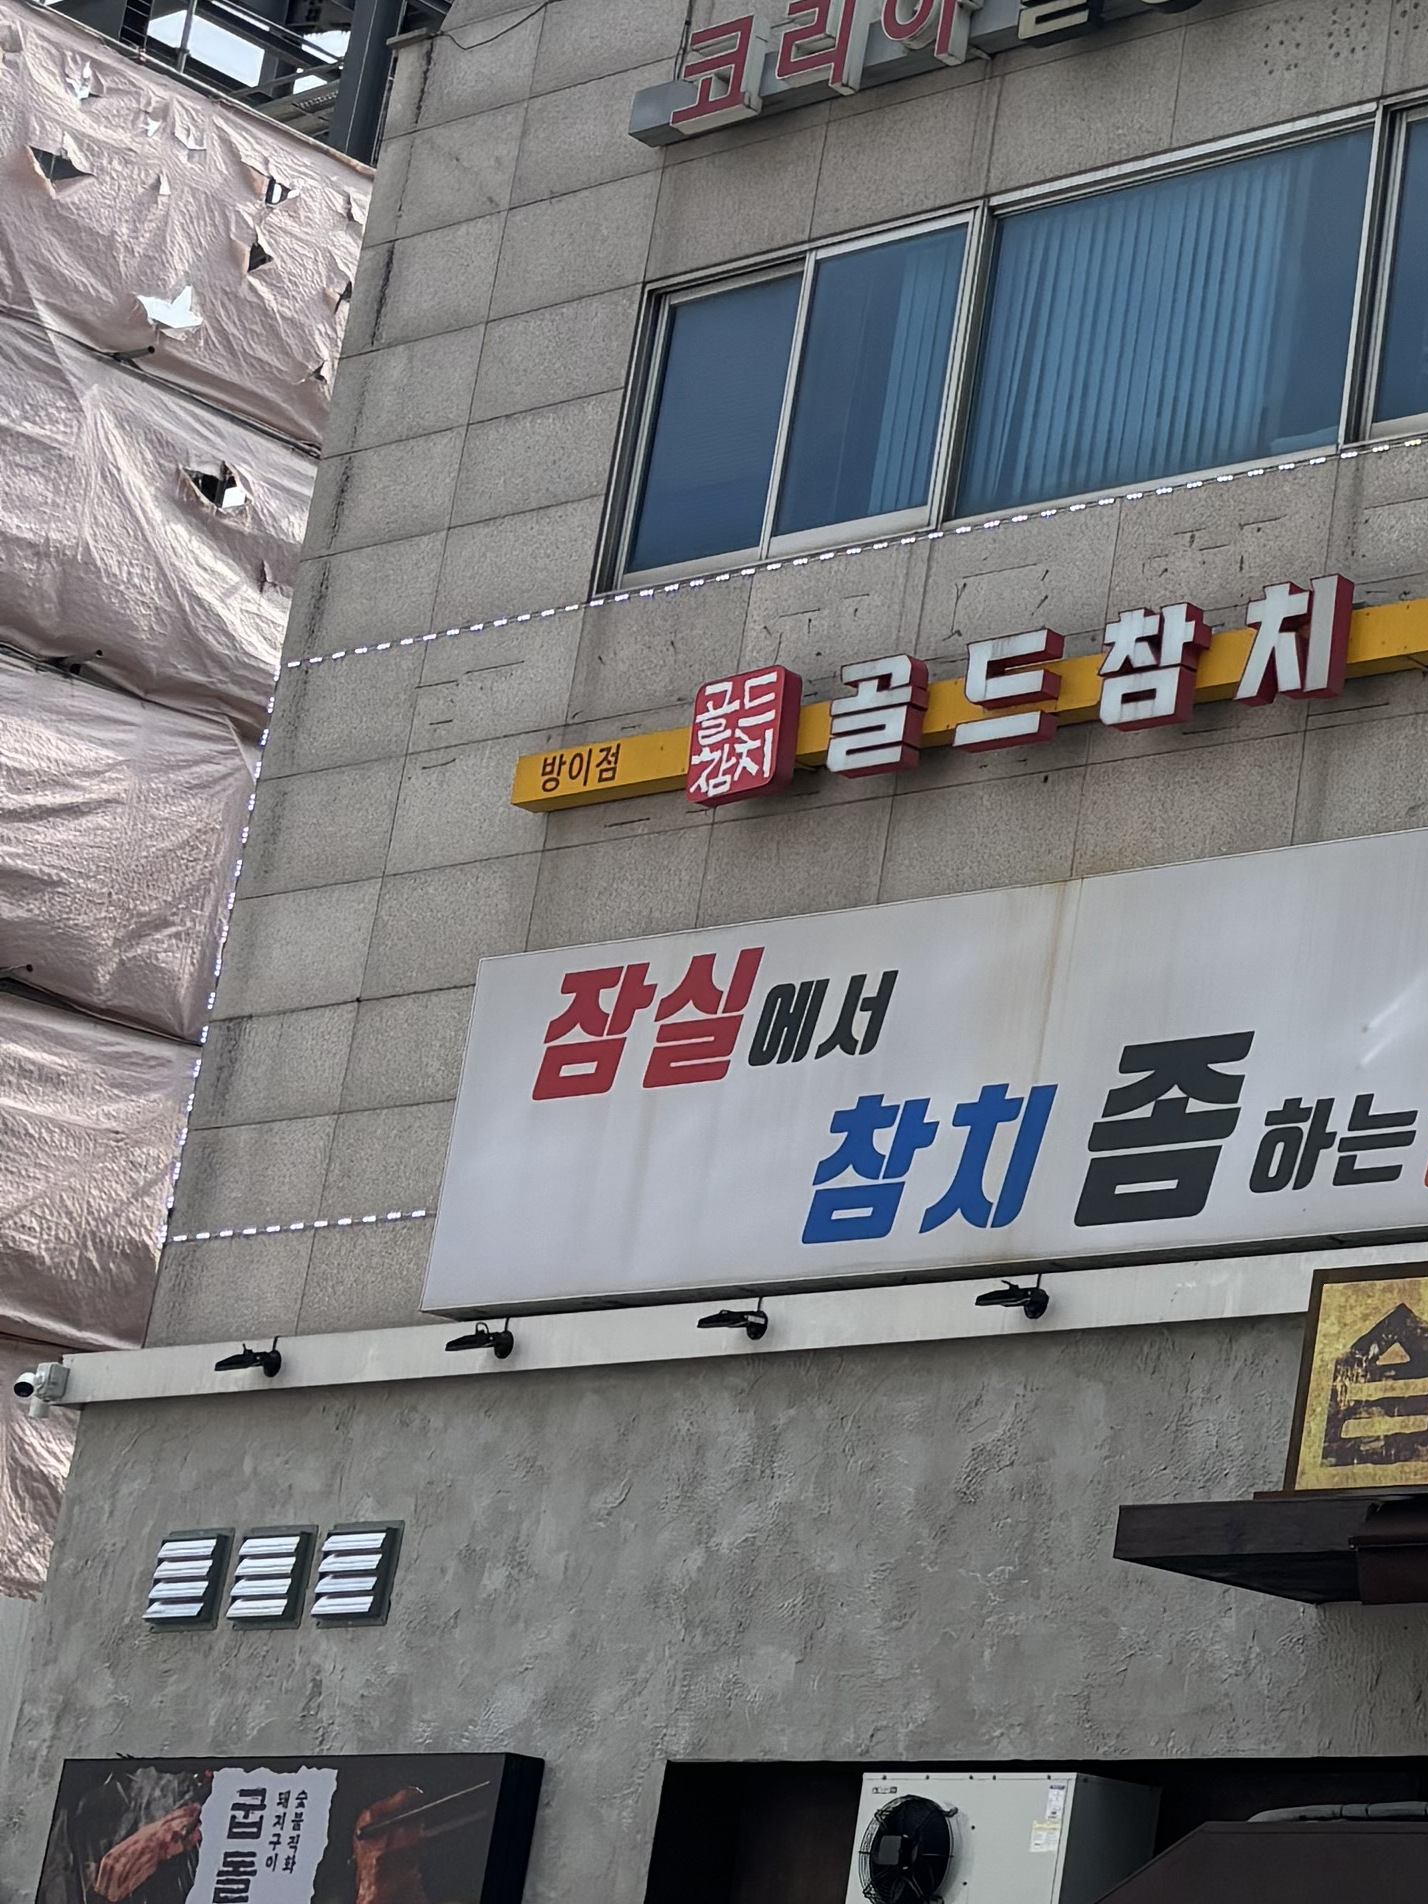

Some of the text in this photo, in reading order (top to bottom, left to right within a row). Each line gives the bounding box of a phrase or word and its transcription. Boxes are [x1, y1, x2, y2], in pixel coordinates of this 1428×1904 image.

[826, 573, 1352, 779] 골드참치
[540, 741, 621, 792] 방이점
[531, 946, 899, 1101] 잠실에서
[801, 1083, 1059, 1245] 참치
[265, 1789, 291, 1872] 돼지구이
